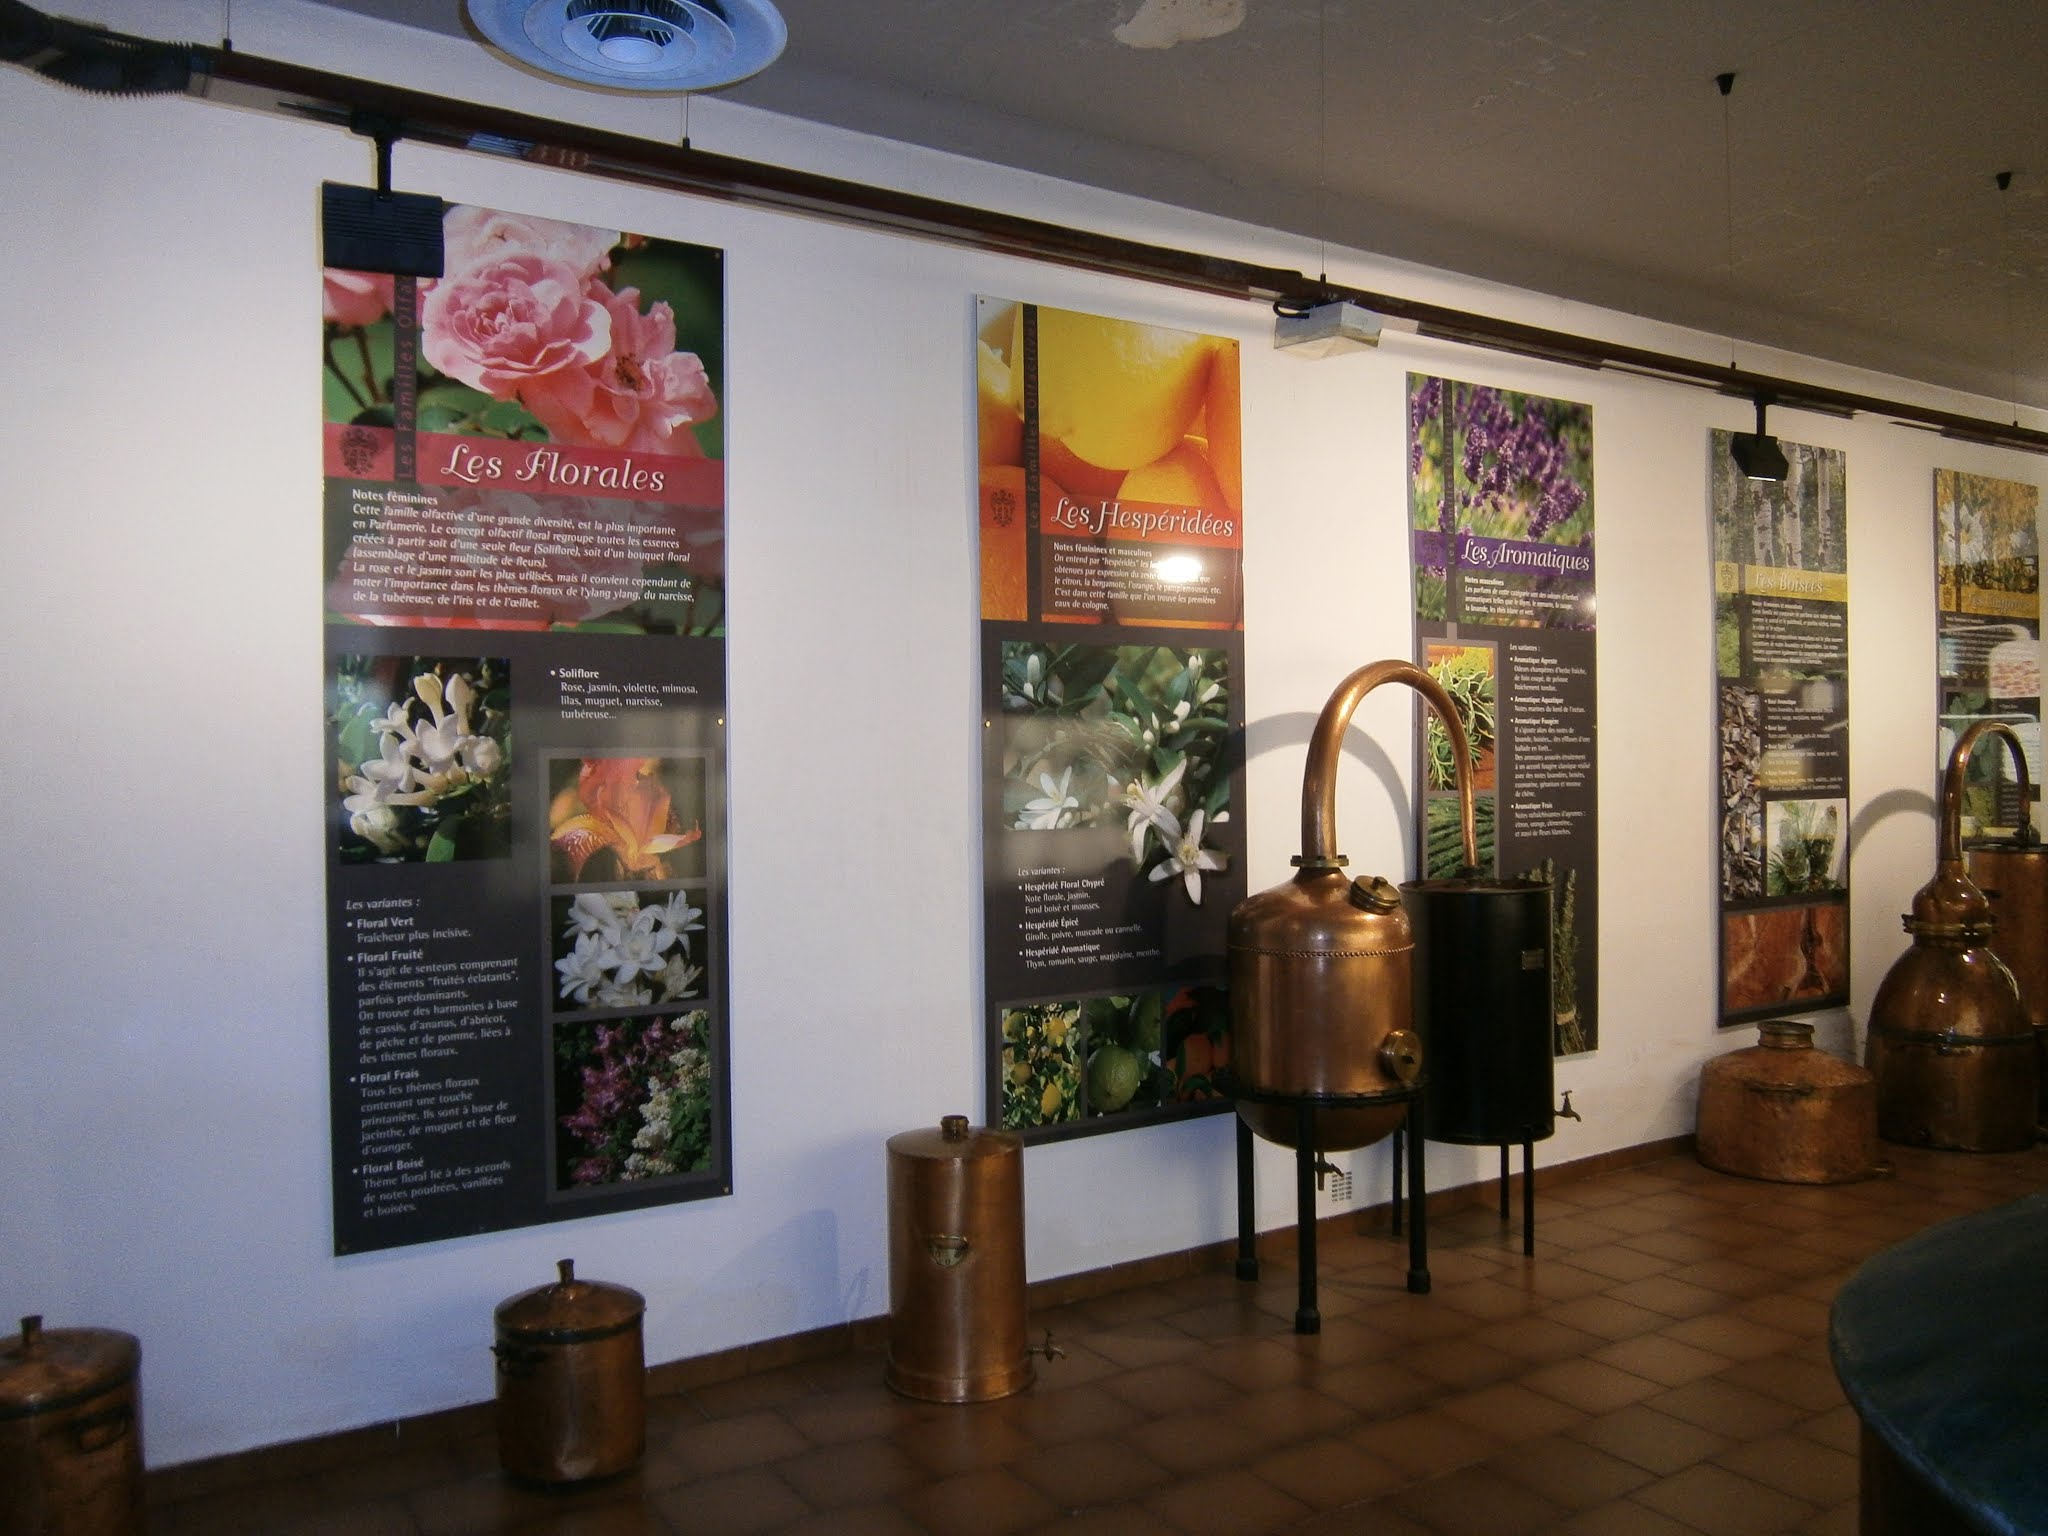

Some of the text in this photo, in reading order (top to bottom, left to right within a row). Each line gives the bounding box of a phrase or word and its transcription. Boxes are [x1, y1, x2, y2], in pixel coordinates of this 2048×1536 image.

[441, 443, 666, 492] Les Florales
[353, 490, 384, 502] Notes
[353, 504, 381, 516] Cette
[384, 506, 419, 519] famille
[422, 509, 464, 522] olfactive
[467, 512, 495, 524] d'une
[498, 514, 531, 528] grande
[578, 519, 591, 530] est
[595, 520, 603, 531] la
[605, 521, 624, 534] plus
[627, 522, 676, 538] importante
[1051, 496, 1233, 537] Les Hespéridées
[353, 520, 680, 549] en Parfumerie. Le concept olfactif floral regroupe toutes les essences
[388, 538, 394, 547] à
[397, 537, 426, 551] partir
[429, 538, 447, 550] soit
[450, 540, 478, 552] d'une
[482, 541, 506, 553] seule
[509, 543, 531, 555] fleur
[584, 547, 601, 558] soit
[604, 548, 625, 560] d'un
[628, 549, 665, 564] bouquet
[668, 552, 691, 563] floral
[1461, 538, 1590, 574] Les Aromatiques
[418, 551, 447, 563] d'une
[450, 553, 498, 566] multitude
[501, 555, 513, 566] de
[354, 563, 691, 591] La rose et le jasmin sont les plus utilisés, mais il convient cependant de
[354, 577, 381, 589] noter
[385, 578, 448, 594] l'importance
[451, 581, 474, 593] dans
[477, 582, 490, 594] les
[494, 583, 528, 595] thèmes
[531, 585, 563, 597] floraux
[566, 587, 578, 597] de
[613, 589, 641, 602] ylang,
[644, 590, 656, 601] du
[659, 591, 695, 603] narcisse,
[560, 668, 599, 679] Soliflore
[561, 683, 698, 695] Rose, jasmin, violette, mimosa,
[561, 696, 663, 708] lilas, muguet, narcisse,
[346, 897, 413, 910] Les variantes
[357, 917, 414, 929] Floral Vert
[409, 930, 430, 943] plus
[433, 928, 471, 940] incisive.
[358, 950, 423, 963] Floral Fruité
